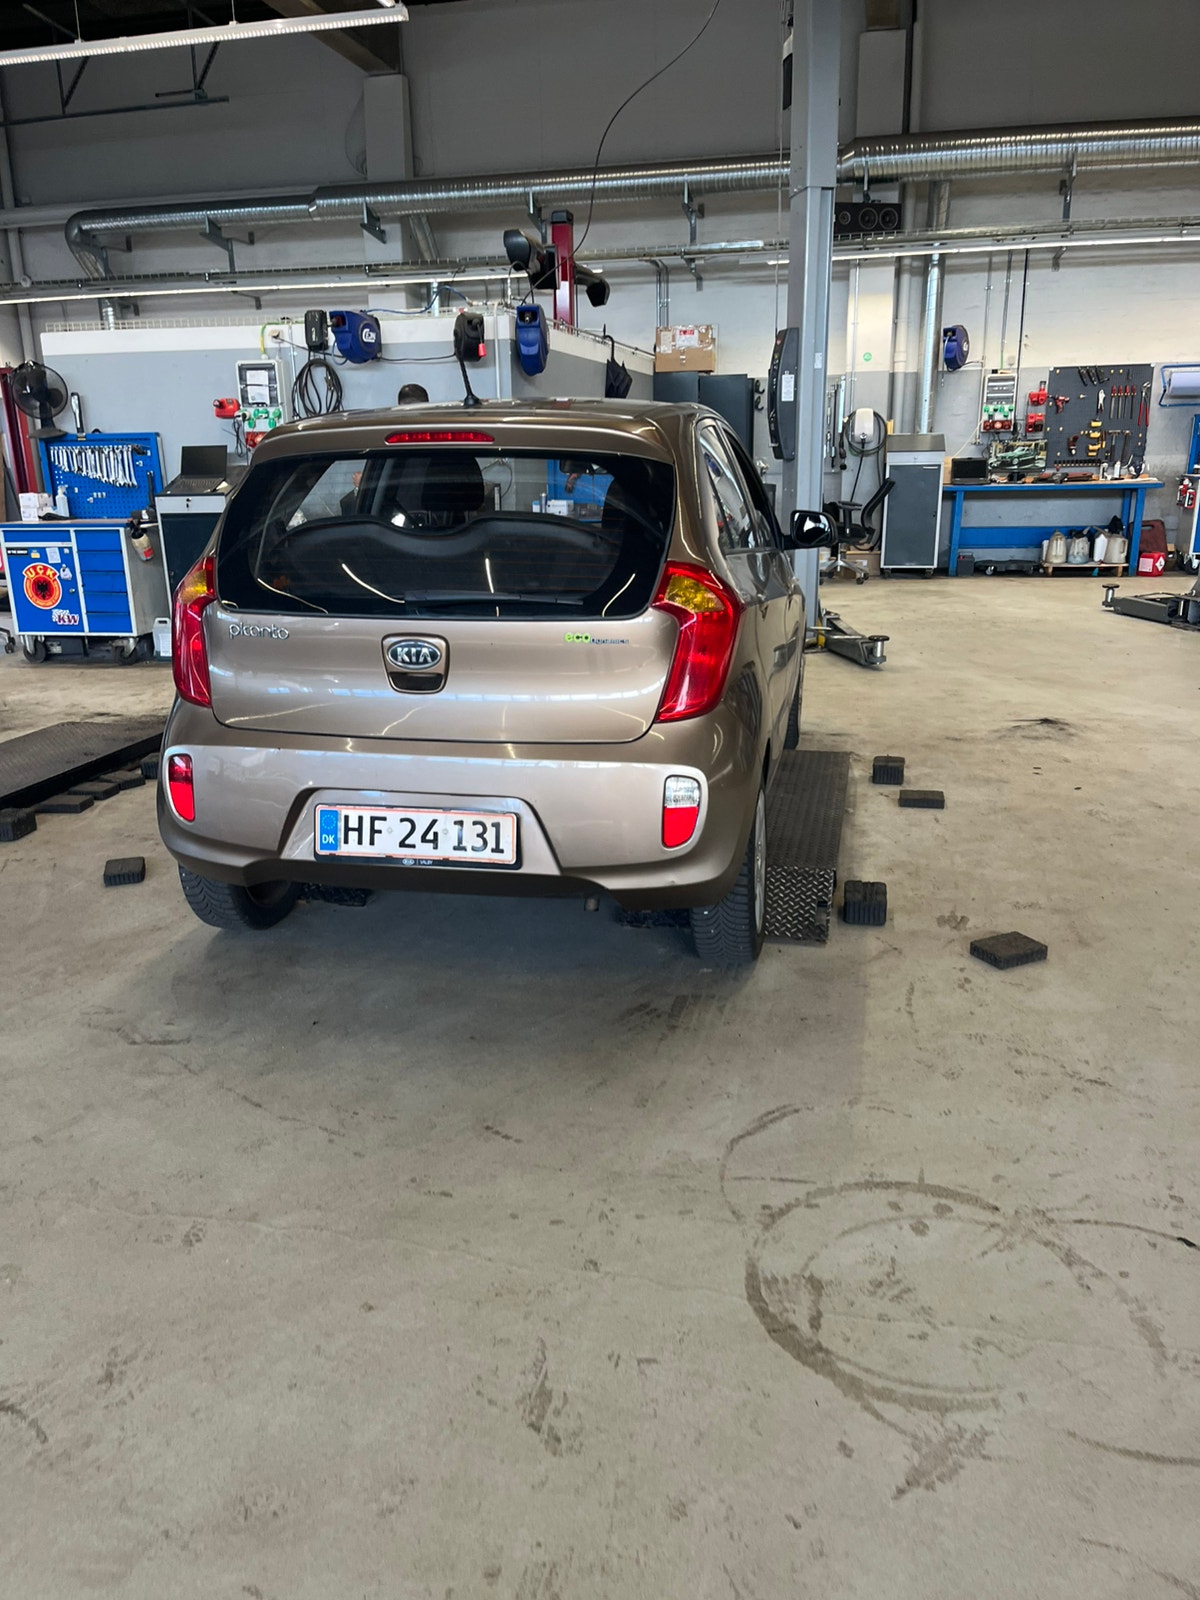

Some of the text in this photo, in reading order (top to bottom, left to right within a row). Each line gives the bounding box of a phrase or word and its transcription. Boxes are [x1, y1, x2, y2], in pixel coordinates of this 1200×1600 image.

[229, 622, 289, 640] picanto
[396, 647, 432, 663] KIA
[321, 834, 336, 845] DK
[343, 814, 505, 854] HF 24 131
